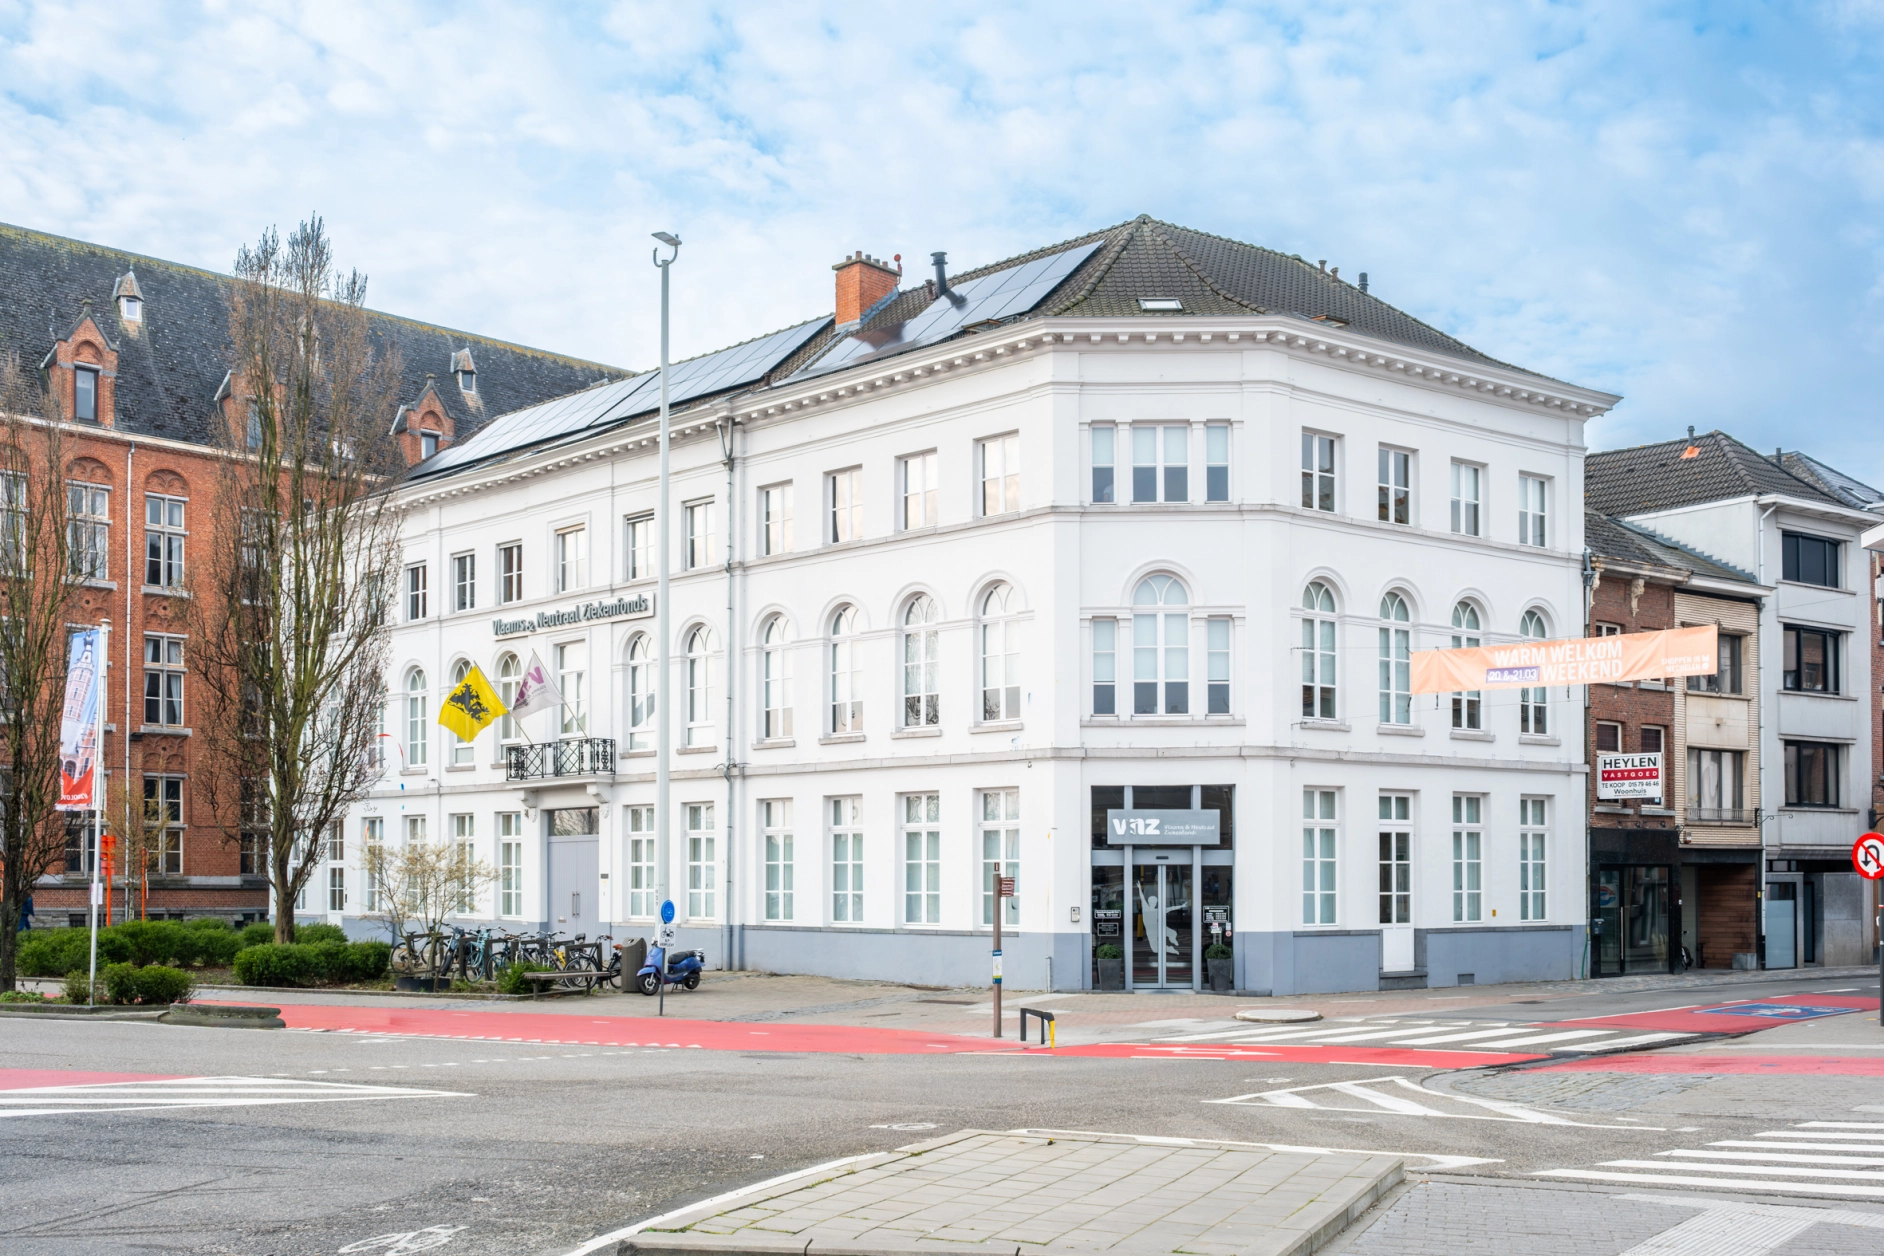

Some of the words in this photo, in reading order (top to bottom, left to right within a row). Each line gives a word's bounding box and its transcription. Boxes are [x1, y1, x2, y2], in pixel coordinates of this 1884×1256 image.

[492, 619, 526, 636] Vlaams
[526, 621, 536, 633] &
[536, 604, 581, 628] Neutraal
[582, 594, 648, 620] Ziekenfonds
[1494, 647, 1546, 667] WARM
[1549, 640, 1623, 664] WELKOM
[1661, 656, 1692, 666] SHOPPEN
[1694, 655, 1701, 663] IN
[1488, 671, 1501, 682] 20
[1503, 670, 1511, 681] &
[1511, 668, 1537, 681] 21.03
[1542, 659, 1623, 682] WEEKEND
[1665, 663, 1701, 673] MECHELEN
[1603, 757, 1657, 769] HEYLEN
